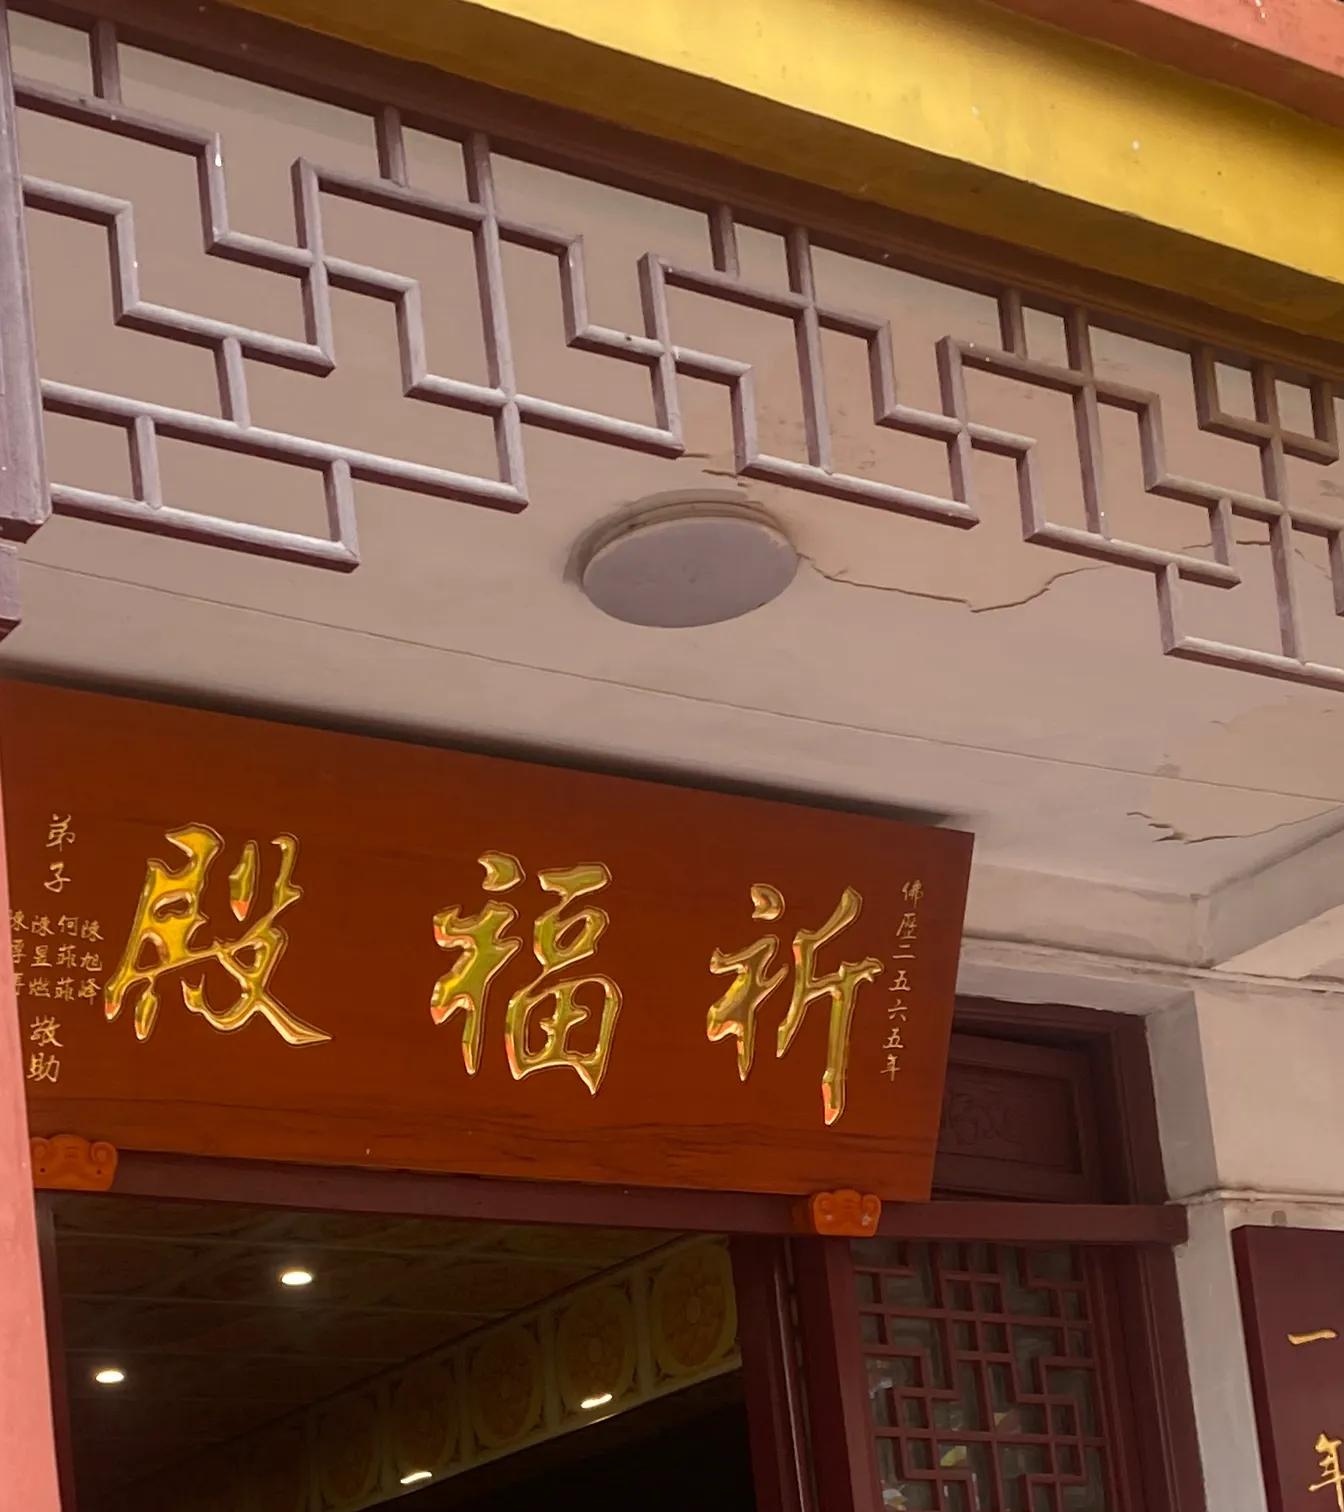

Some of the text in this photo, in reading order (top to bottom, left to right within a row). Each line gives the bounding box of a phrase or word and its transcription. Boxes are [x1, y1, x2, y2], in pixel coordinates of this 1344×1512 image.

[45, 814, 75, 892] 弟子
[103, 821, 885, 1127] 祈福殿
